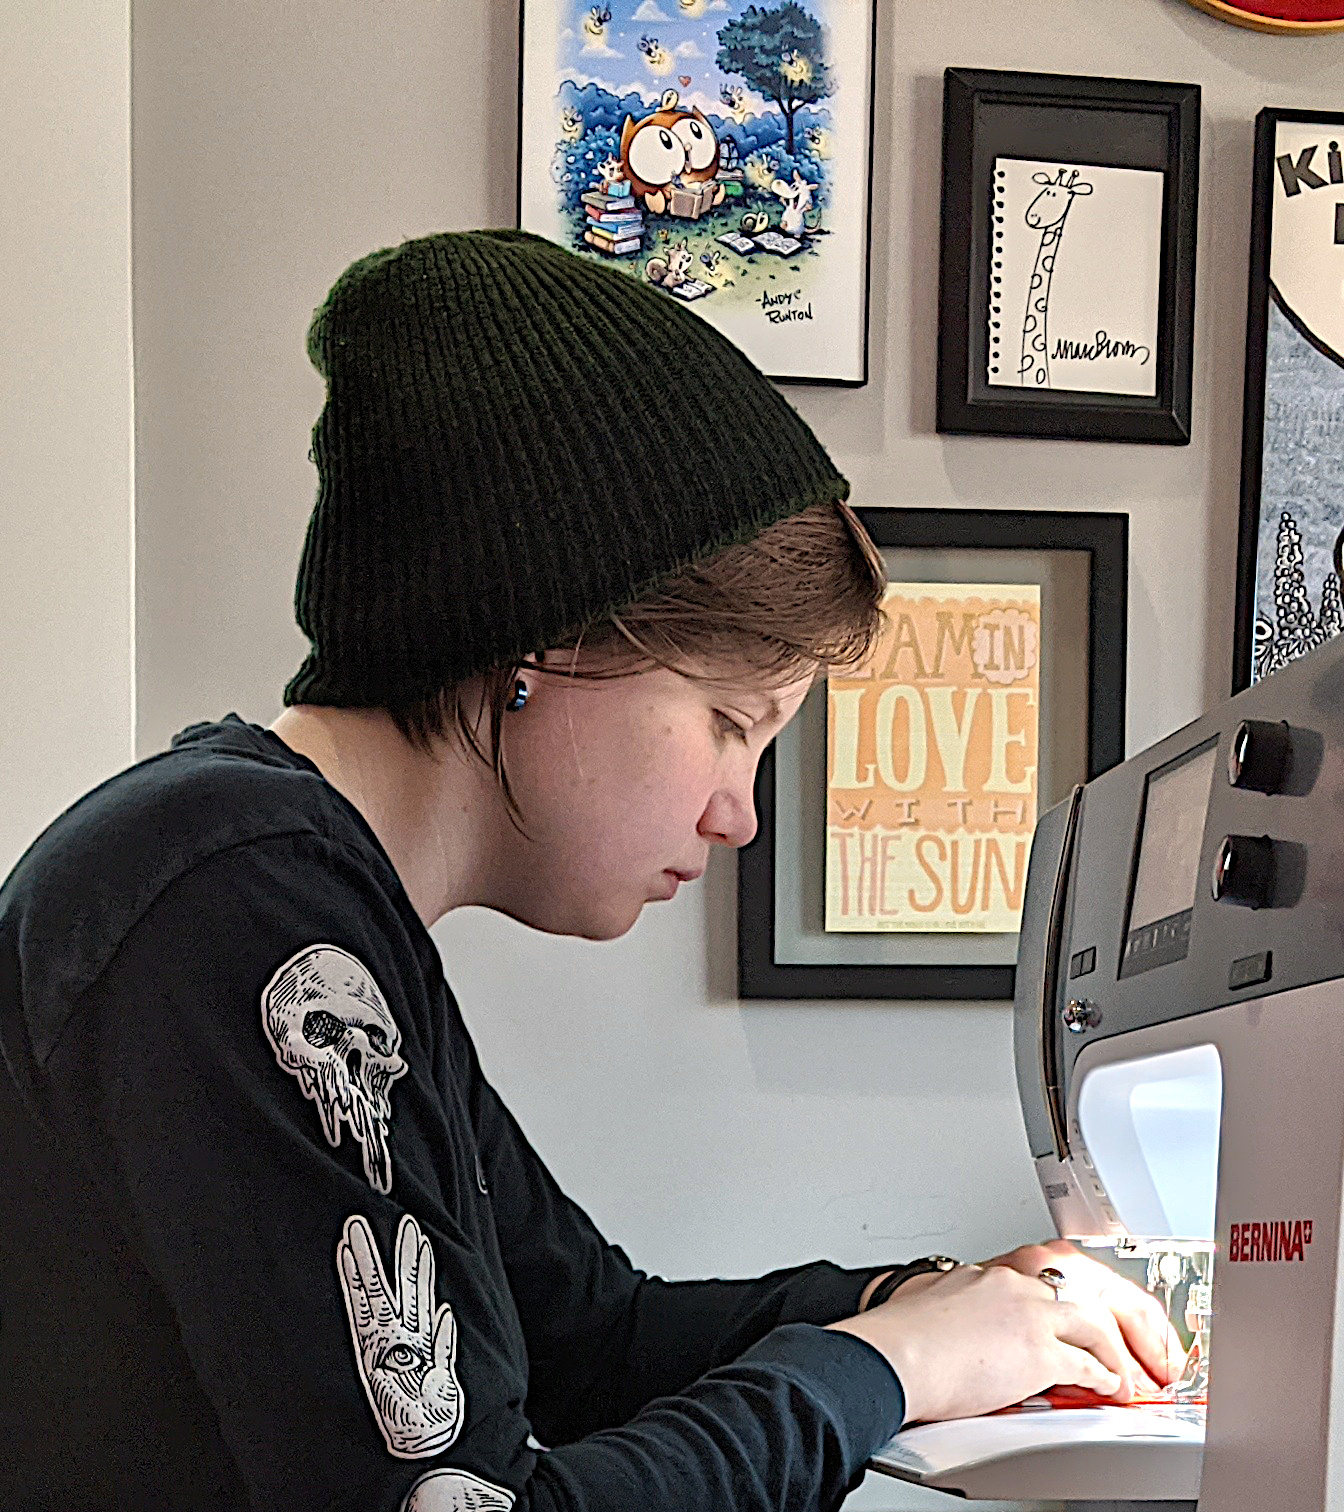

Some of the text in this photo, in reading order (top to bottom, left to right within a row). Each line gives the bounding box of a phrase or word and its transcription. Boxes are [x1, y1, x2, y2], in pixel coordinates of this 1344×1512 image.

[879, 610, 1027, 680] AM IN
[829, 684, 1036, 795] LOVE
[834, 798, 1029, 826] WITH
[830, 831, 1025, 917] THE SUN
[1229, 1220, 1304, 1262] BERNINA
